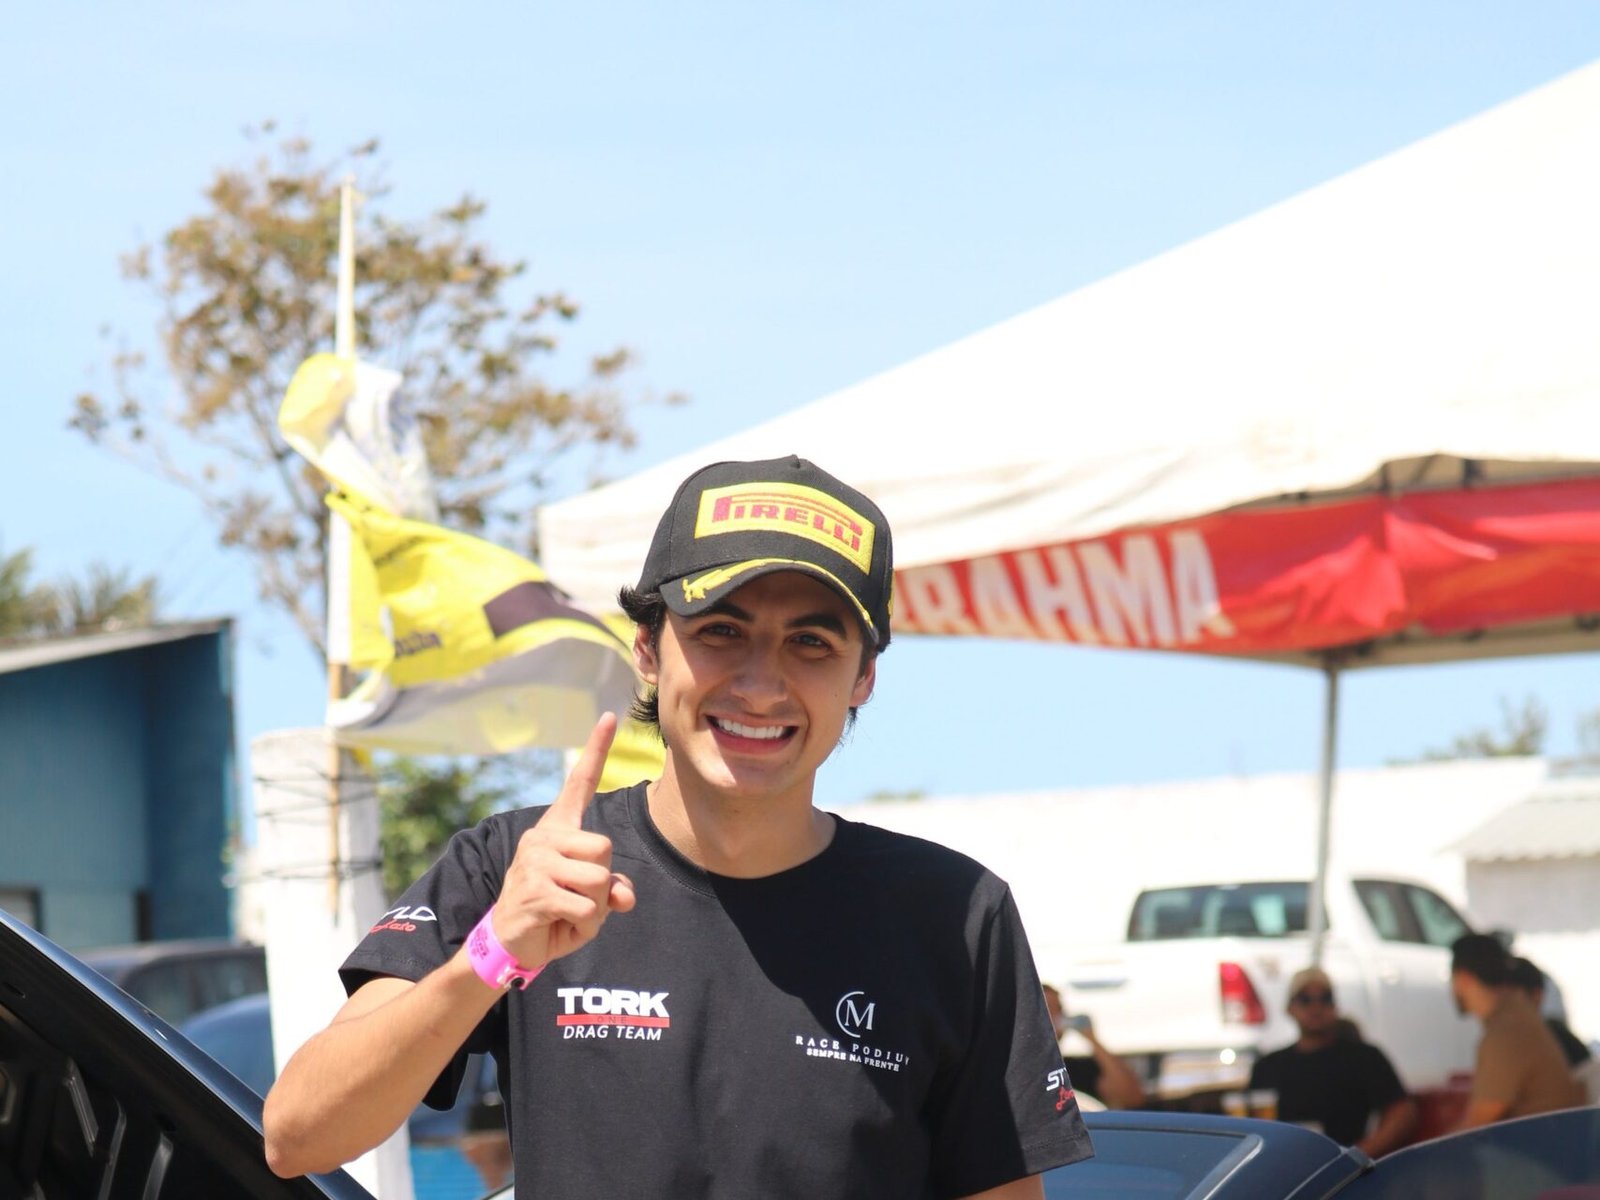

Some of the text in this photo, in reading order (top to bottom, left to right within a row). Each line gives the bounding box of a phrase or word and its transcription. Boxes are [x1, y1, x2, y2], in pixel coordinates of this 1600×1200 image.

[711, 493, 863, 552] PIRELLI
[557, 987, 670, 1017] TORK
[563, 1025, 662, 1041] DRAG TEAM
[795, 1035, 840, 1050] RACE
[806, 1048, 900, 1072] SEMPRE NA FRENTE
